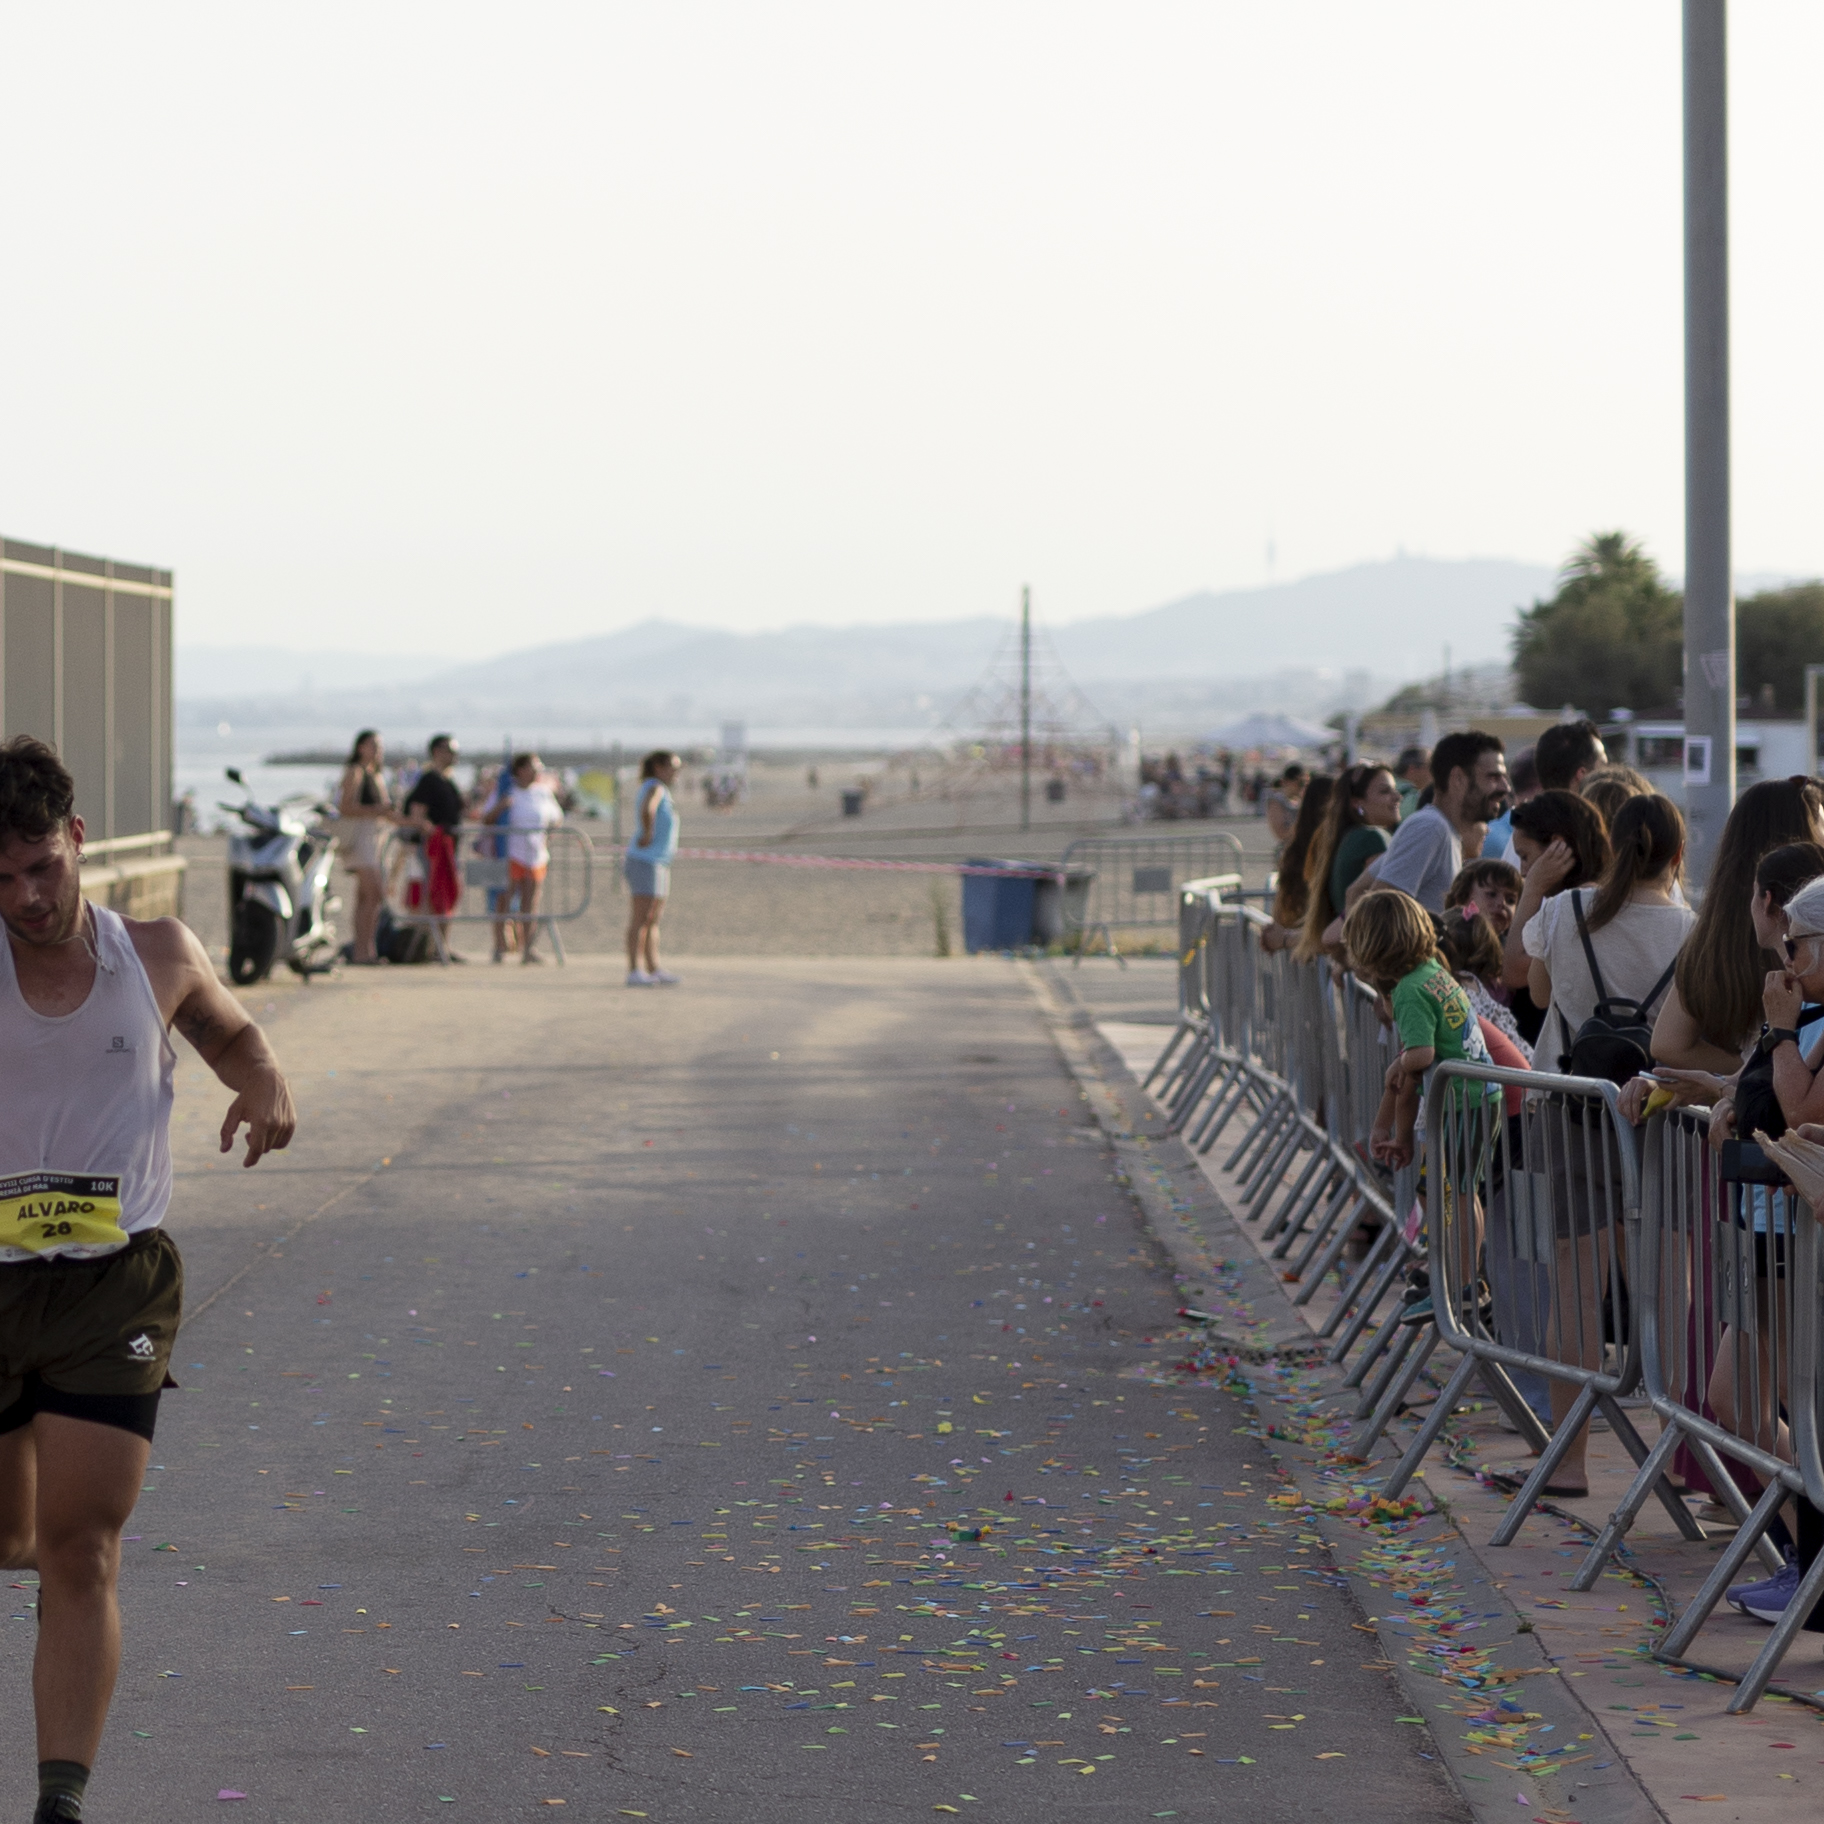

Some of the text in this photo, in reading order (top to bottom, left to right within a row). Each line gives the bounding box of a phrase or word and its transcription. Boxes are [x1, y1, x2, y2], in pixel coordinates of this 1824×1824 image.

[18, 1175, 42, 1186] CURSA
[90, 1181, 114, 1192] 10K
[17, 1201, 95, 1222] ALVARO
[42, 1221, 72, 1239] 28
